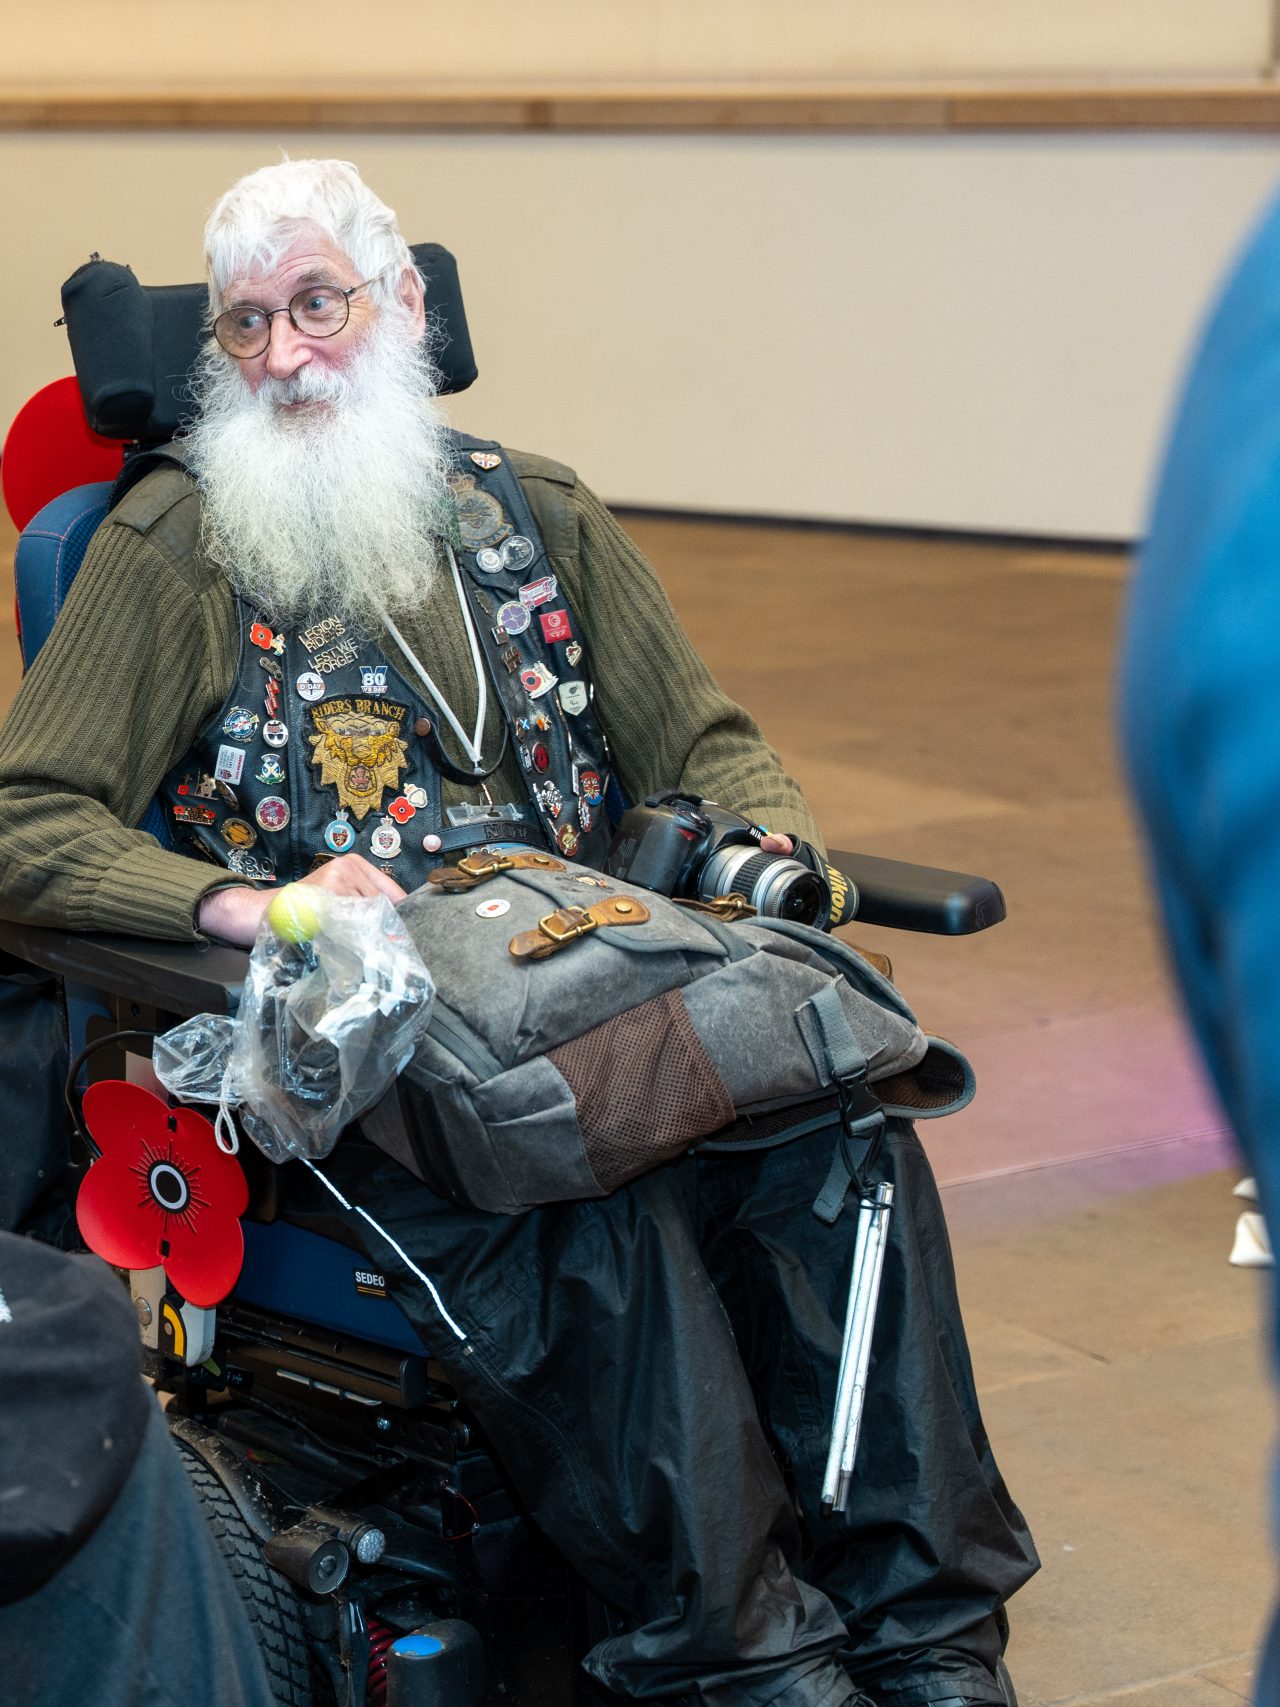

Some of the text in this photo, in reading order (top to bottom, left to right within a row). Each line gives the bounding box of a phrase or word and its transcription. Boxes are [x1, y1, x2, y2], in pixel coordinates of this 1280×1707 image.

[298, 615, 341, 646] LEGION
[308, 637, 359, 670] LEST WE
[315, 648, 359, 677] FORGET
[362, 672, 387, 687] 80
[311, 699, 406, 721] RIDERS BRANCH
[825, 863, 849, 924] Nikon
[355, 1271, 385, 1287] SEDEO
